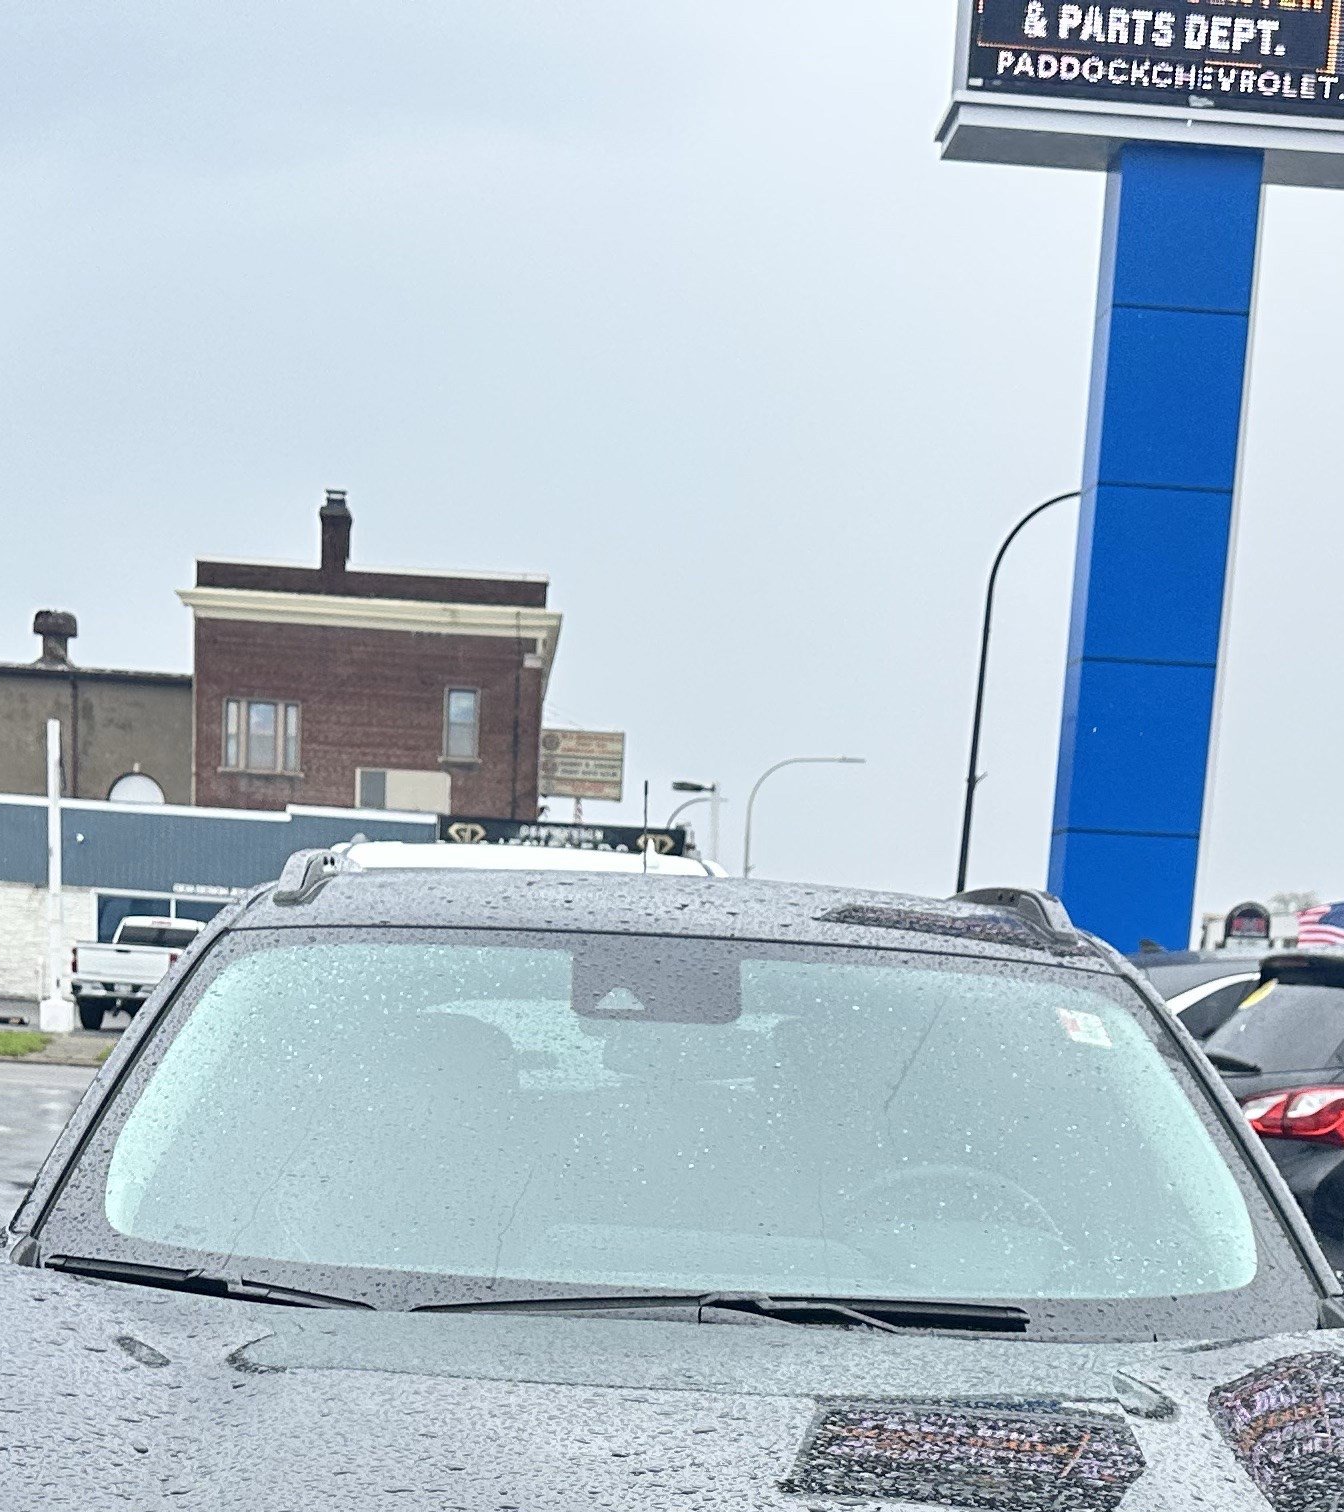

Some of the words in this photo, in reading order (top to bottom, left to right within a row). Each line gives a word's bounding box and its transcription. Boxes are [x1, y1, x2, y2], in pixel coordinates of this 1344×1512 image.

[1023, 0, 1049, 38] &
[1058, 4, 1176, 46] PARTS
[1184, 13, 1286, 56] DEPT.
